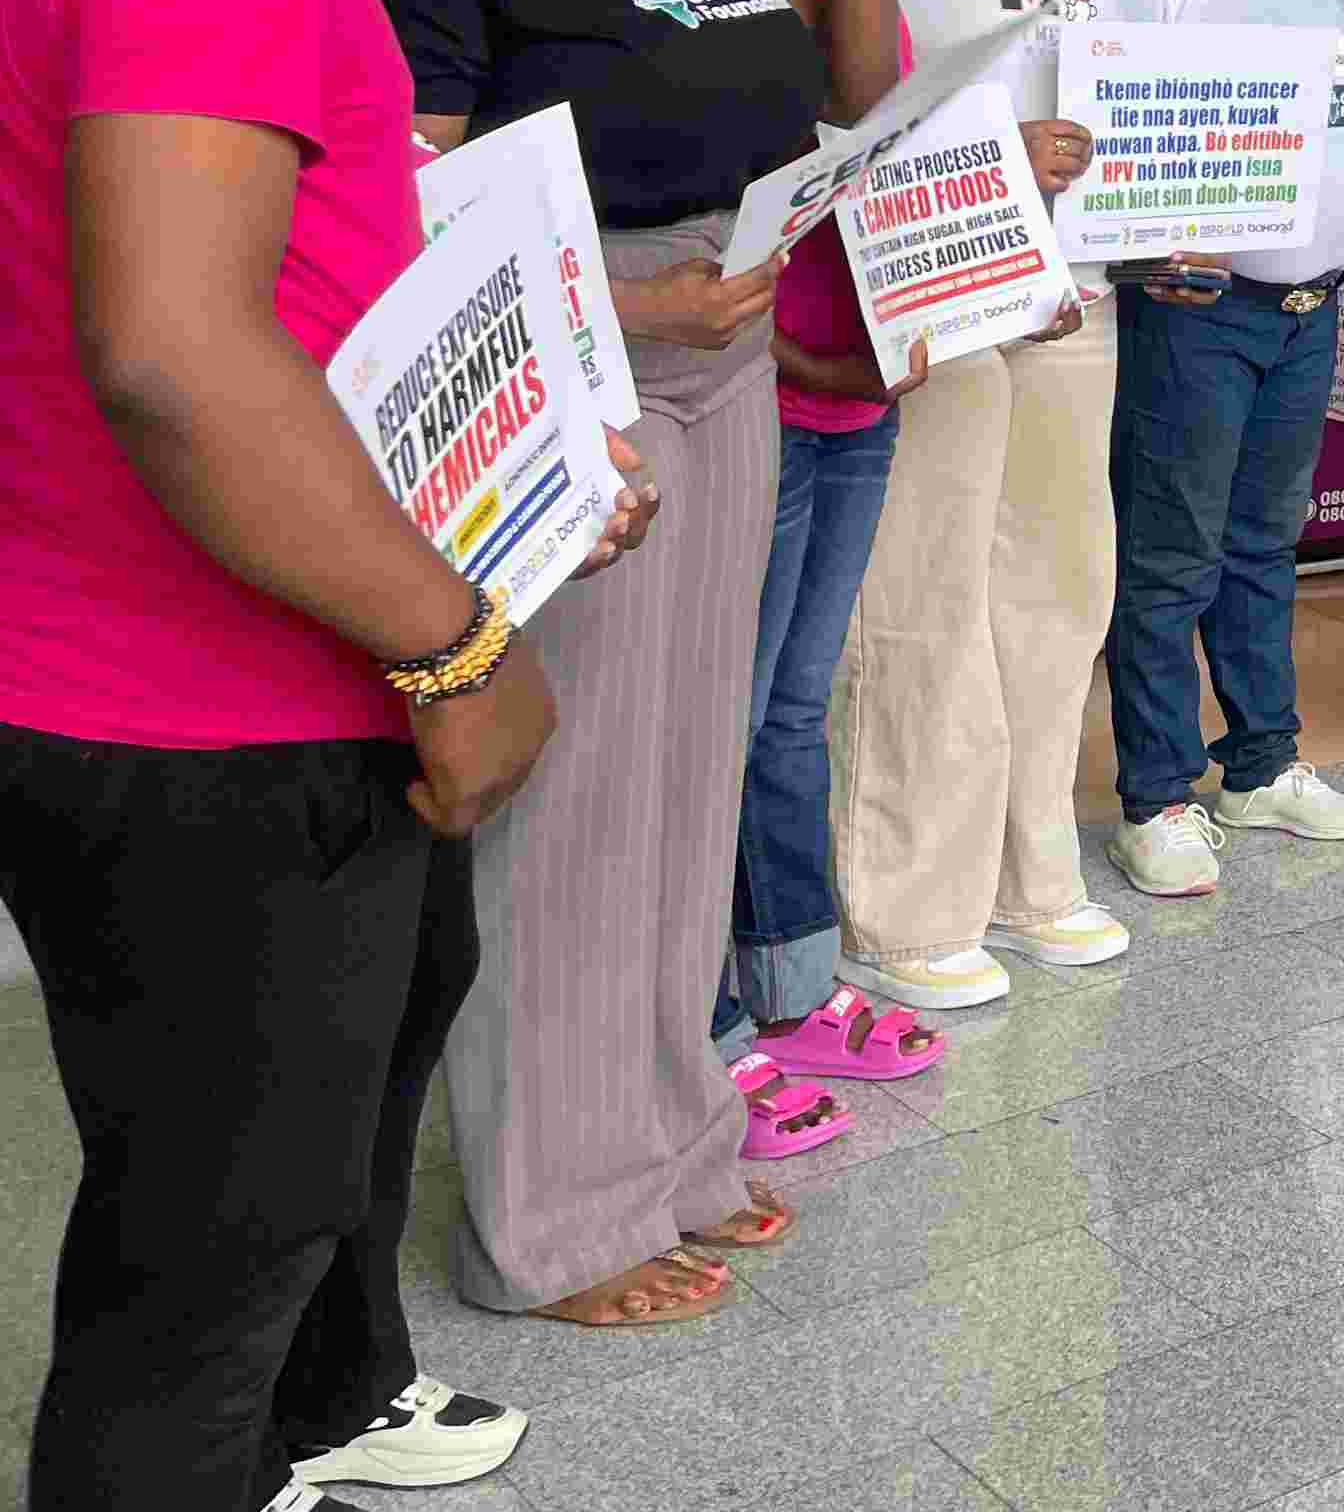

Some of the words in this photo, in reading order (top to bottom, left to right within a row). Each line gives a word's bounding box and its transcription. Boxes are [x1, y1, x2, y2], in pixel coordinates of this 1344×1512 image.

[1096, 79, 1152, 101] Ekeme
[1236, 81, 1300, 99] cancer
[1111, 105, 1139, 128] itie
[1143, 107, 1174, 126] nna
[1228, 105, 1280, 127] kuyak
[870, 159, 913, 192] EATING
[914, 139, 1003, 181] PROCESSED
[1103, 160, 1135, 183] HPV
[1161, 157, 1198, 180] ntok
[1201, 159, 1242, 179] eyen
[1247, 157, 1282, 177] isua
[864, 185, 933, 234] CANNED
[934, 167, 1009, 215] FOODS
[965, 214, 993, 231] HIGH
[1084, 190, 1125, 211] usuk
[1129, 188, 1159, 208] kiet
[1162, 187, 1192, 207] sim
[884, 247, 933, 286] EXCESS
[937, 225, 1030, 268] ADDITIVES
[375, 342, 441, 450] REDUCE
[437, 253, 525, 370] EXPOSURE
[387, 429, 417, 504] TO
[420, 306, 535, 465] HARMFUL
[415, 354, 547, 536] HEMICALS
